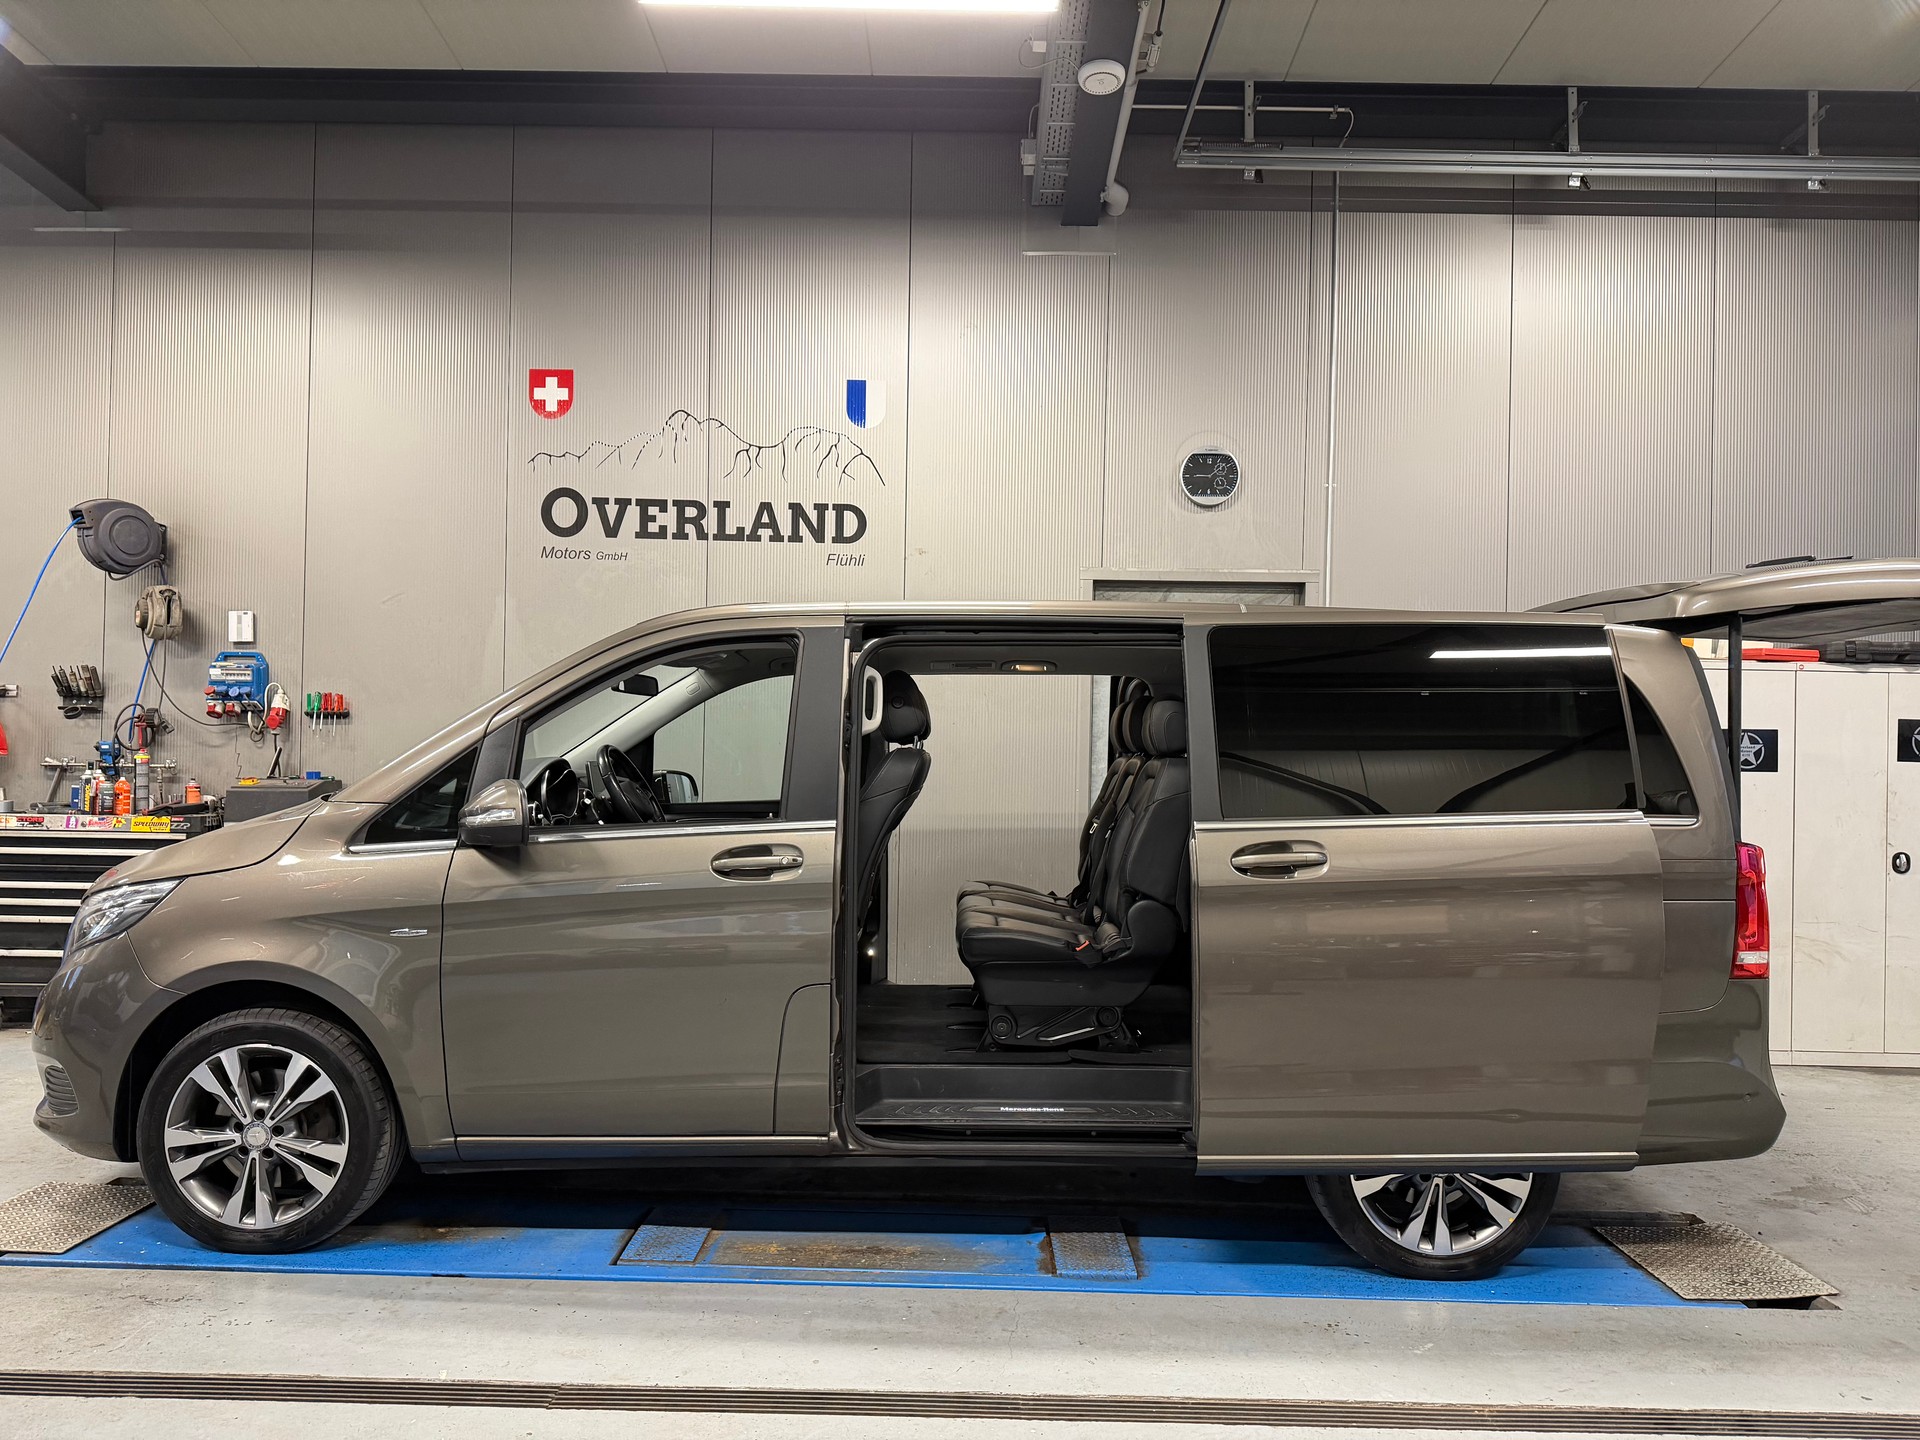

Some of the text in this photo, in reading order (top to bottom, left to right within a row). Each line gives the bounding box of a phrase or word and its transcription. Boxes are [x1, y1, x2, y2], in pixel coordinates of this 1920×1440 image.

[541, 487, 867, 544] OVERLAND
[541, 546, 628, 561] Motors GmbH
[826, 553, 866, 567] Flühli
